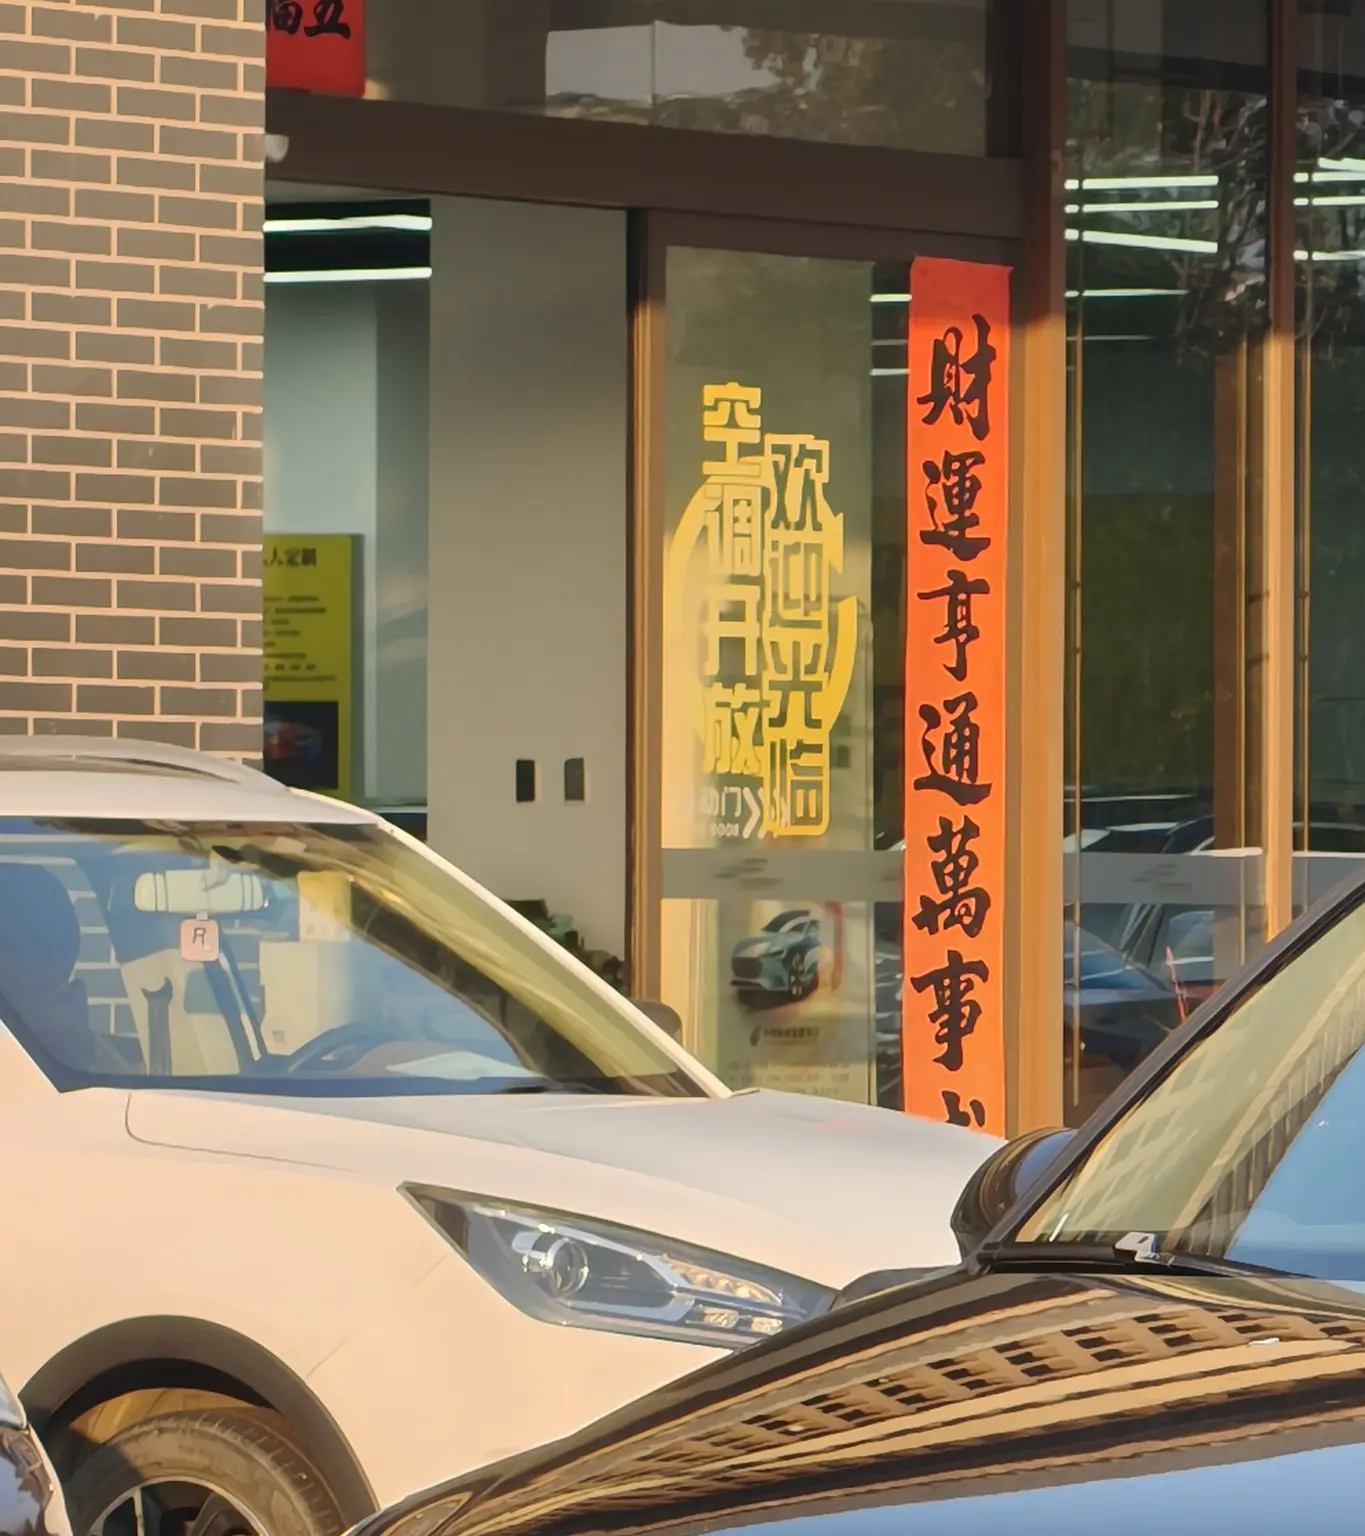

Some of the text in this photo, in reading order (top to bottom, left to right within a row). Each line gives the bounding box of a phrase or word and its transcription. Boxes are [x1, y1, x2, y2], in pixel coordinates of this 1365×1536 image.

[702, 381, 762, 776] 空调开放
[763, 432, 830, 836] 欢迎光临
